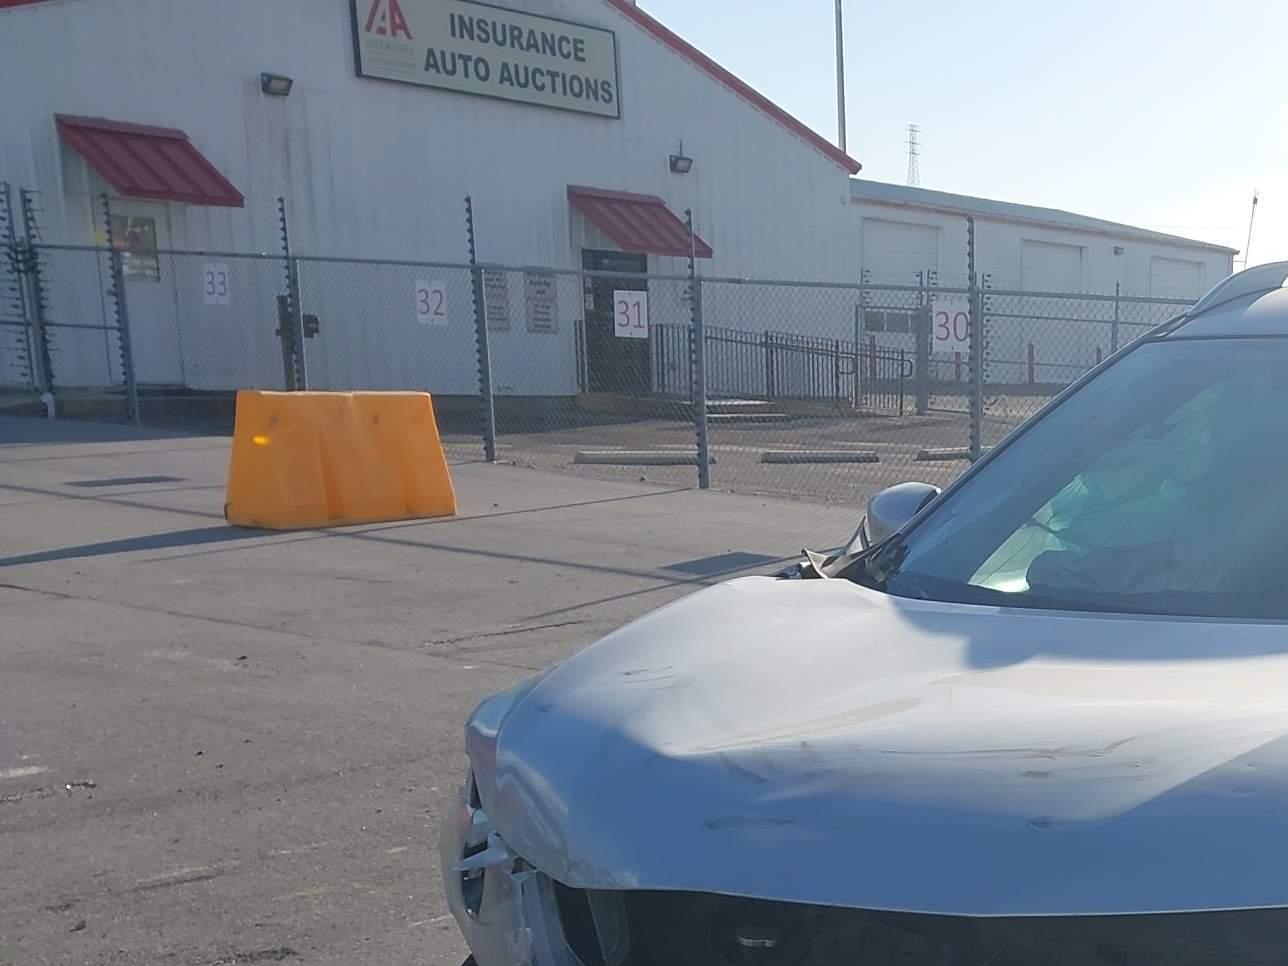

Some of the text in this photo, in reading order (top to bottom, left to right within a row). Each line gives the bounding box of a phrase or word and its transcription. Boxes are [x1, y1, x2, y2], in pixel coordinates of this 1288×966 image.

[449, 13, 586, 62] INSURANCE
[424, 48, 490, 82] AUTO
[498, 62, 613, 104] AUCTIONS
[205, 271, 229, 297] 33
[417, 288, 446, 316] 32
[617, 300, 645, 328] 31
[935, 311, 969, 342] 30
